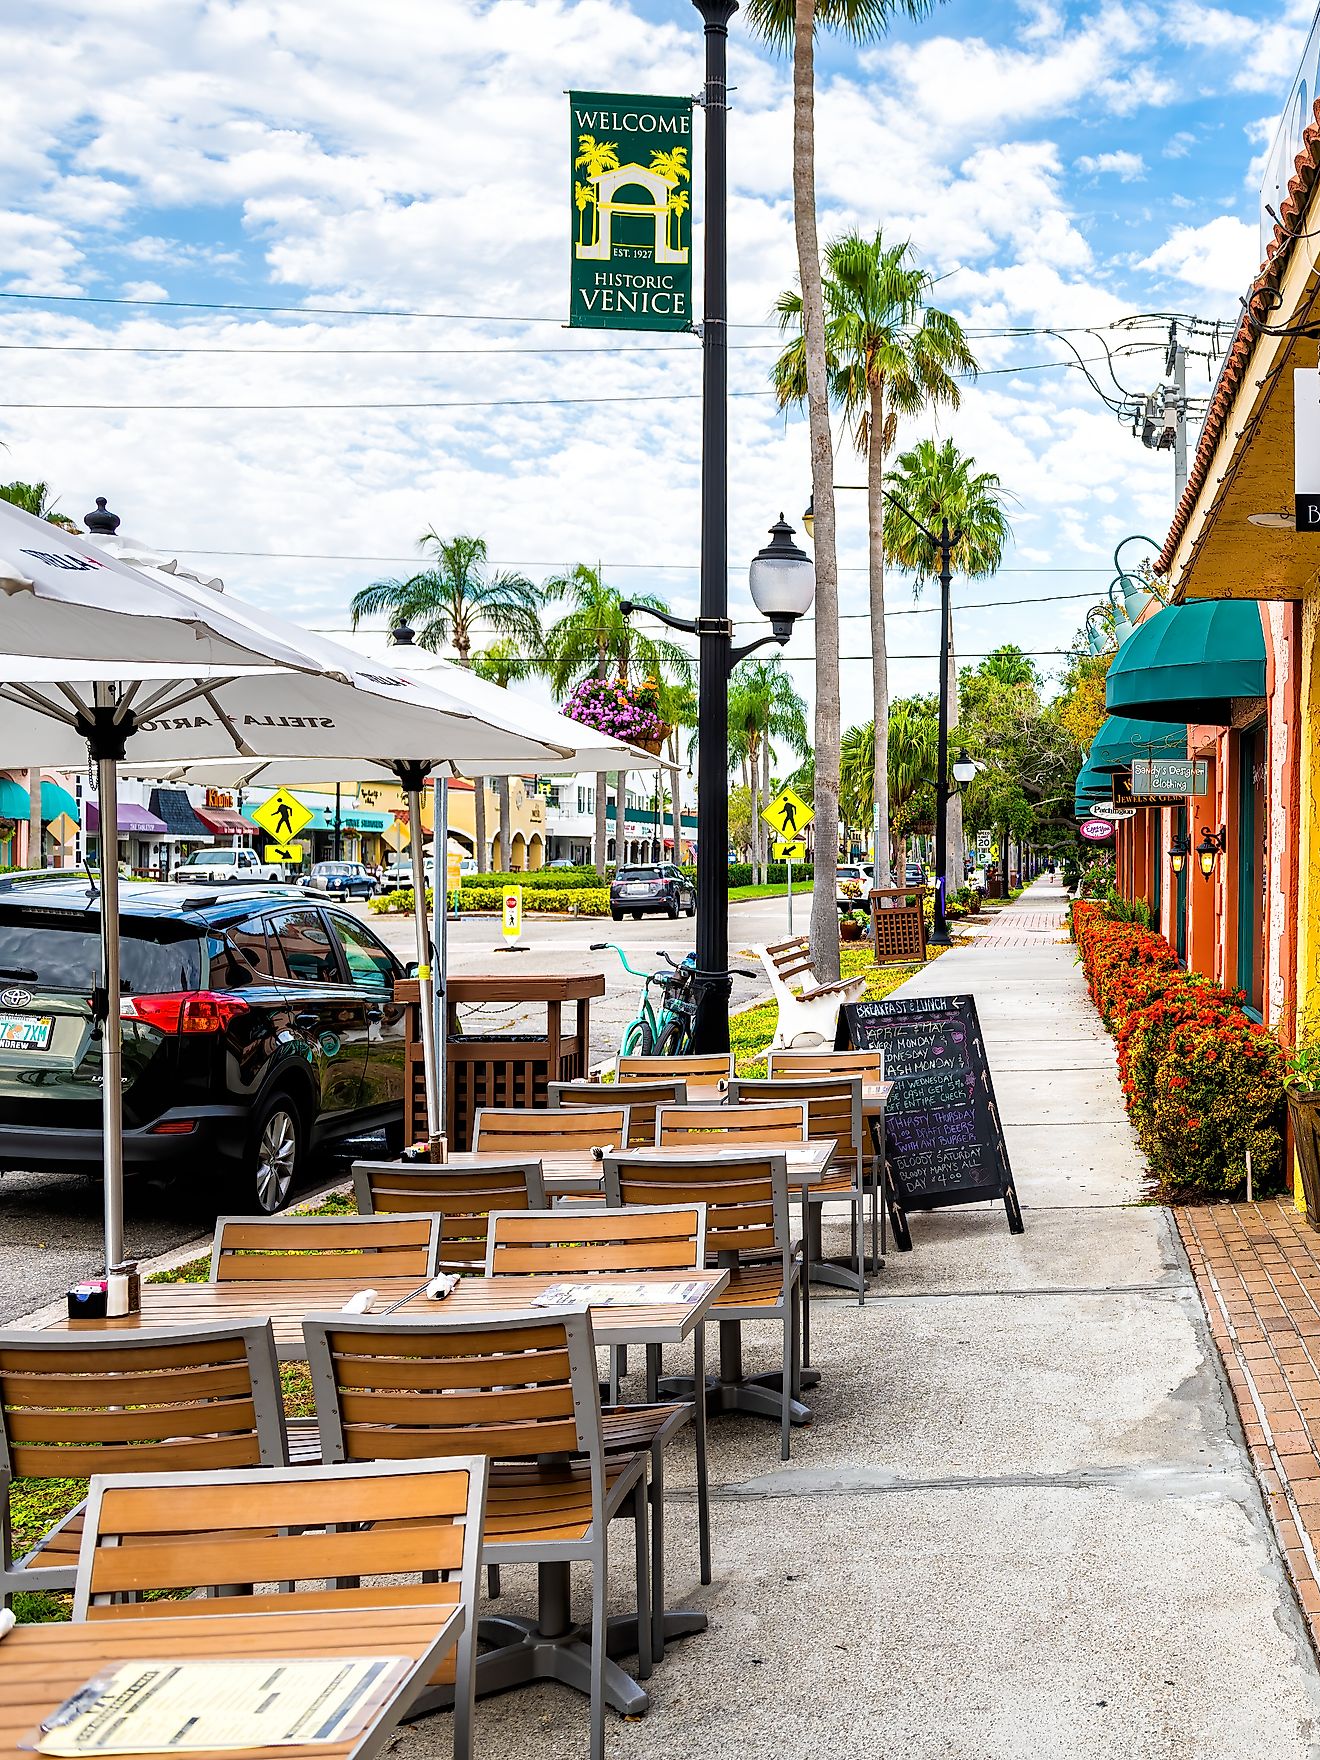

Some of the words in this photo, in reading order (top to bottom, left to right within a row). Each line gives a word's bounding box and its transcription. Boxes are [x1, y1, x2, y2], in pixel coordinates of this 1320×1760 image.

[575, 110, 690, 134] WELCOME
[613, 247, 631, 257] EST.
[633, 249, 652, 260] 1927
[594, 272, 673, 289] HISTORIC
[579, 288, 685, 314] VENICE
[1135, 764, 1167, 779] Sandy's
[1169, 765, 1205, 779] Designer
[1152, 778, 1187, 791] Clothing
[856, 1001, 906, 1018] BREAKFAST
[916, 998, 947, 1012] LUNCH
[865, 1026, 908, 1040] APRIL
[921, 1021, 948, 1034] MAY
[868, 1041, 893, 1051] EVERY
[897, 1034, 935, 1050] MONDAY
[885, 1048, 929, 1063] DNESDAY
[885, 1064, 912, 1077] ASH
[914, 1056, 955, 1073] MONDAY
[894, 1081, 905, 1090] SH
[907, 1073, 954, 1089] WEDNESDAY
[886, 1102, 901, 1112] OFF
[904, 1095, 937, 1109] ENTIRE
[940, 1089, 967, 1102] CHECK
[903, 1087, 925, 1100] CASH
[927, 1084, 944, 1095] GET
[886, 1112, 929, 1131] THIRSTY
[932, 1108, 976, 1123] THURSDAY
[916, 1126, 941, 1139] DRAFT
[943, 1120, 975, 1135] BEERS
[898, 1141, 920, 1153] WITH
[921, 1137, 937, 1148] ANY
[939, 1134, 977, 1146] BURGER
[896, 1153, 933, 1170] BLOODY
[936, 1147, 981, 1163] SATURDAY
[899, 1167, 927, 1181] BLOODY
[930, 1162, 959, 1176] MARY'S
[961, 1159, 982, 1169] ALL
[906, 1177, 927, 1193] DAY
